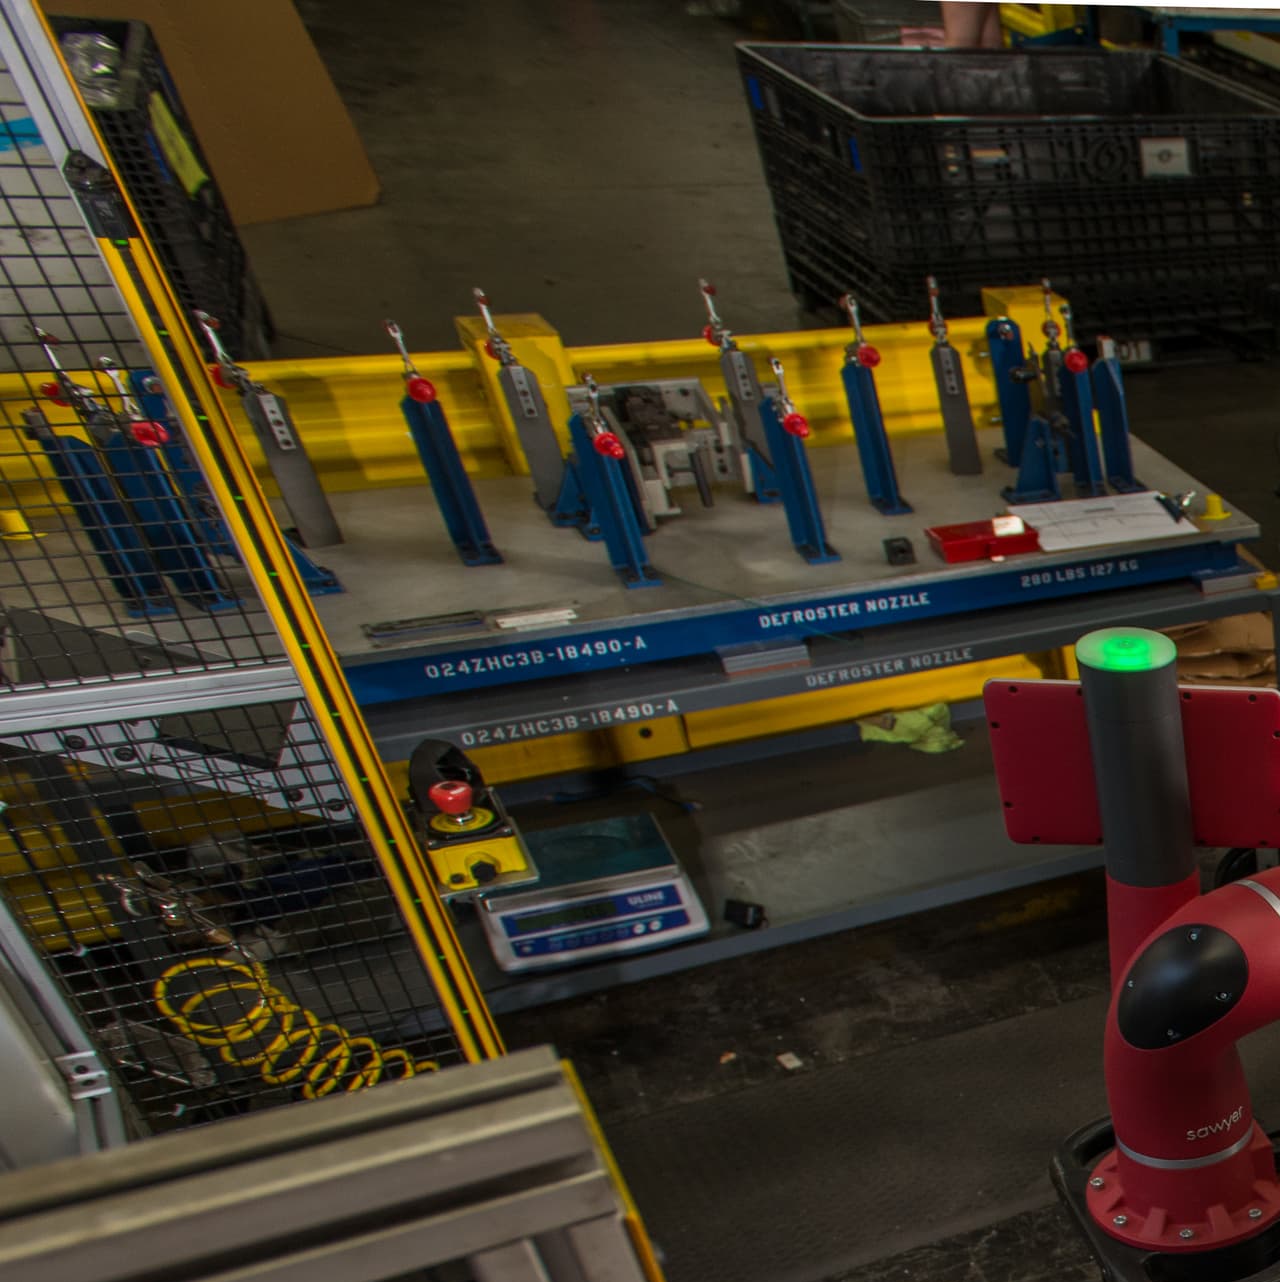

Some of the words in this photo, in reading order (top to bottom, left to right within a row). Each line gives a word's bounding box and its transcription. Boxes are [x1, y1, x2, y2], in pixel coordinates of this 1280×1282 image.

[1020, 571, 1052, 589] 280
[1056, 566, 1086, 582] LBS
[1090, 562, 1114, 577] 127
[1119, 559, 1140, 573] KG
[758, 600, 861, 630] DEFROSTER
[866, 592, 930, 614] NOZZLE
[805, 658, 904, 689] DEFROSTER
[910, 647, 974, 670] NOZZLE
[1186, 1105, 1243, 1141] sawyer
